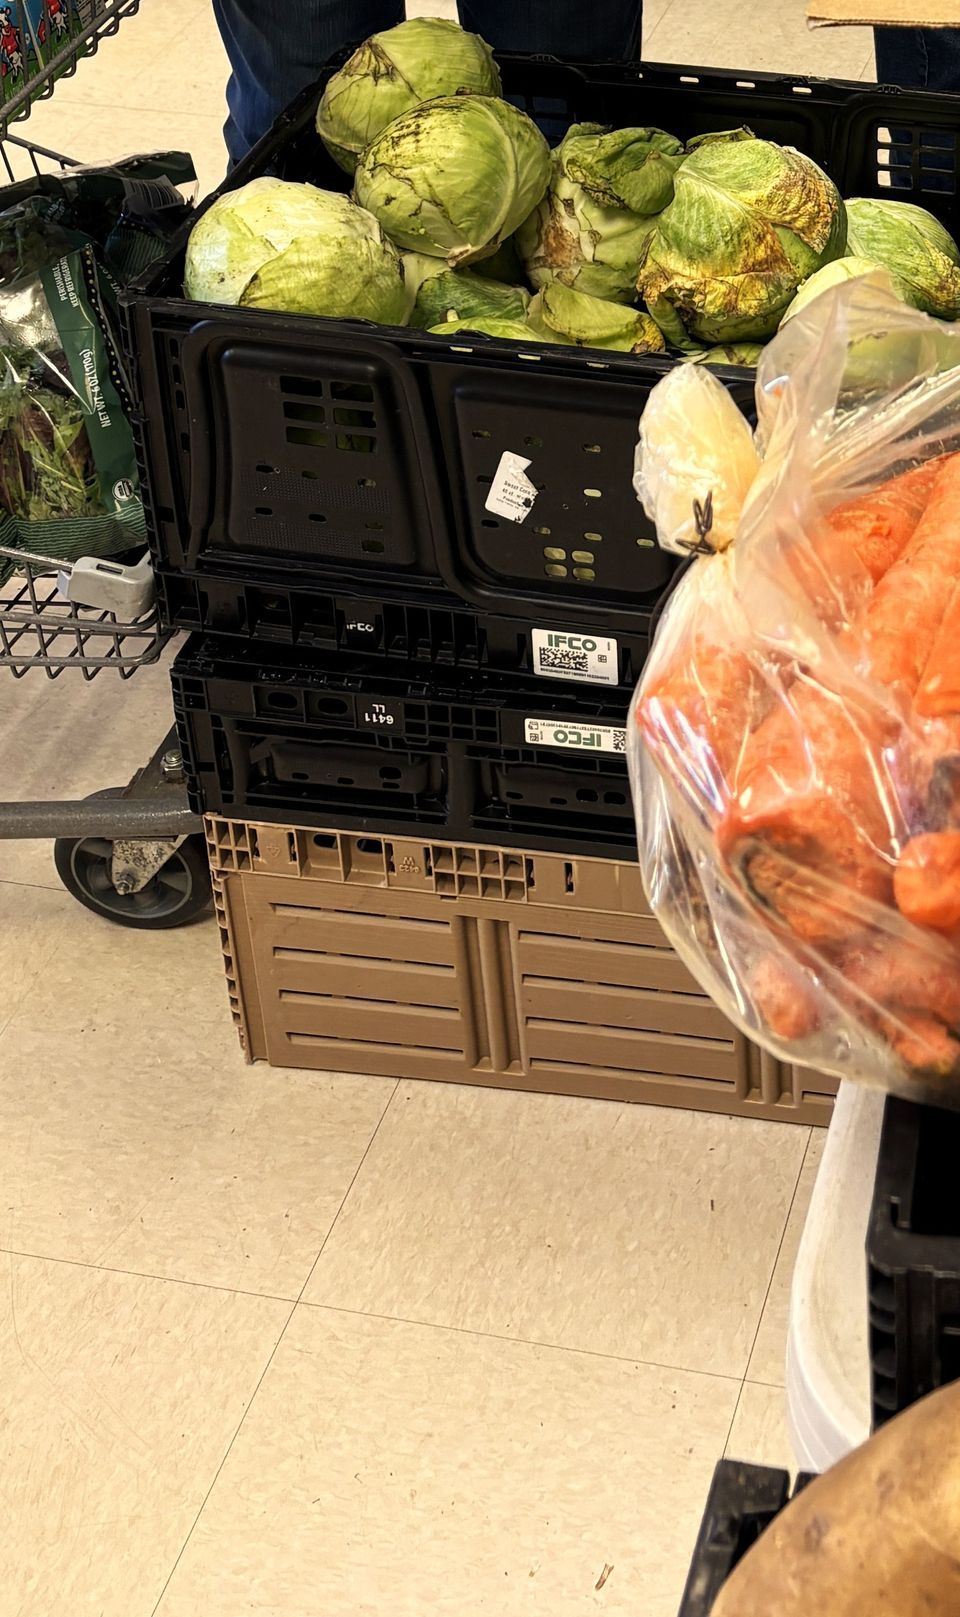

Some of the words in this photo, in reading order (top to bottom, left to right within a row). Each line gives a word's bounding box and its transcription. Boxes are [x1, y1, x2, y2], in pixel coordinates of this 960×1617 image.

[69, 291, 79, 308] KEEP
[100, 410, 112, 428] NET
[346, 622, 374, 633] IFCO
[547, 633, 597, 652] IFCO
[372, 704, 385, 713] LL
[365, 713, 394, 725] 6411
[553, 729, 601, 747] IFCO
